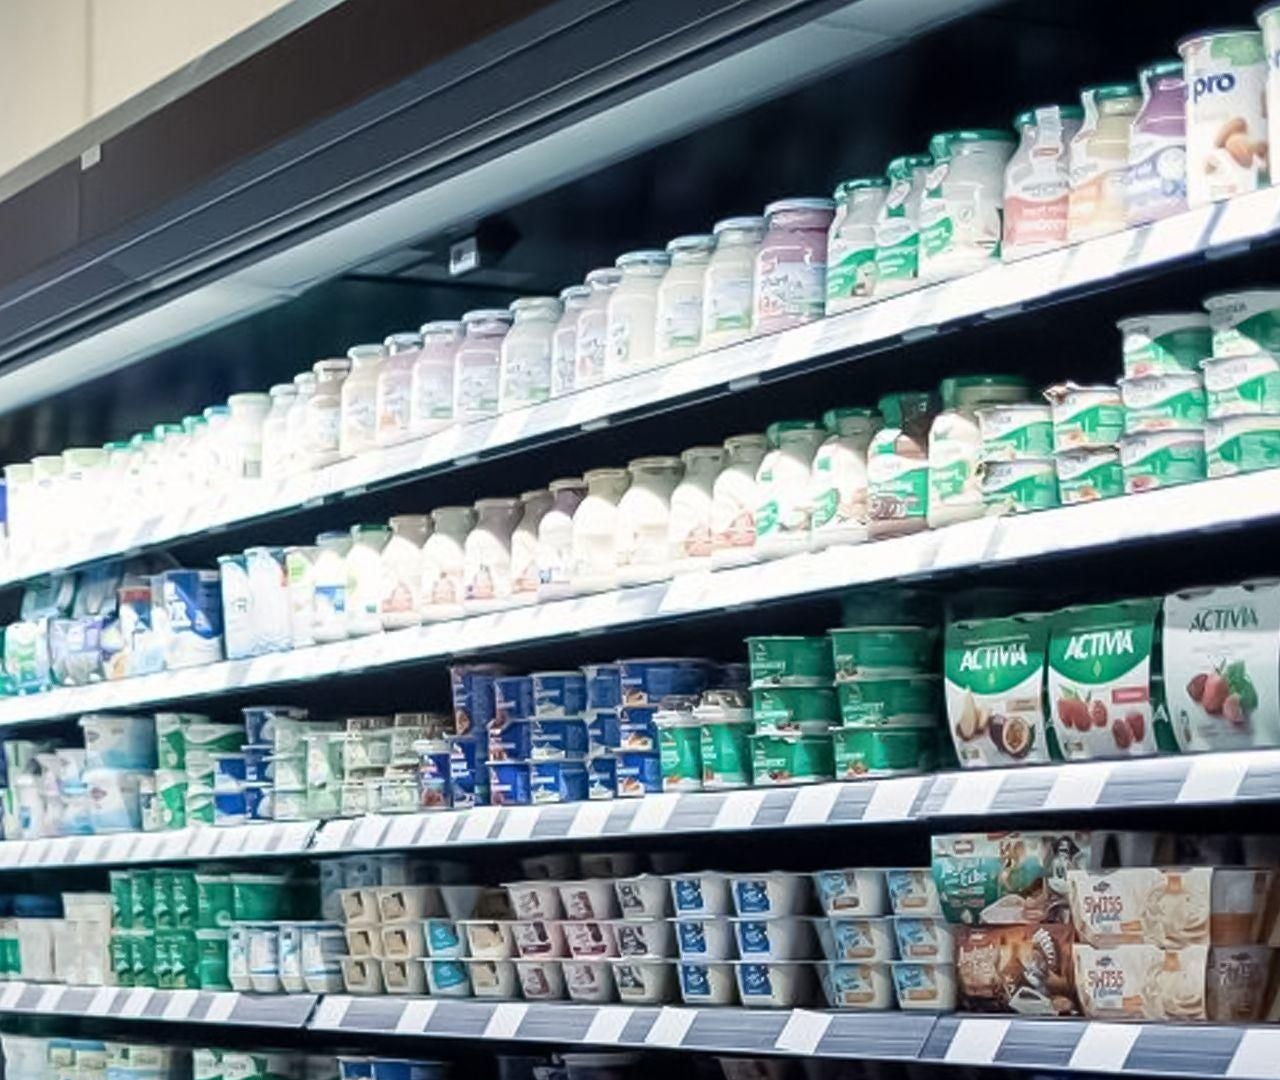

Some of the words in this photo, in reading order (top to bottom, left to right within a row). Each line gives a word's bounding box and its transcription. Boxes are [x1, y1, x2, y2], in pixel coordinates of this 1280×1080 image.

[1189, 607, 1259, 632] ACTIVIA
[960, 643, 1028, 672] ACTIVIA
[1064, 629, 1134, 660] ACTIVIA
